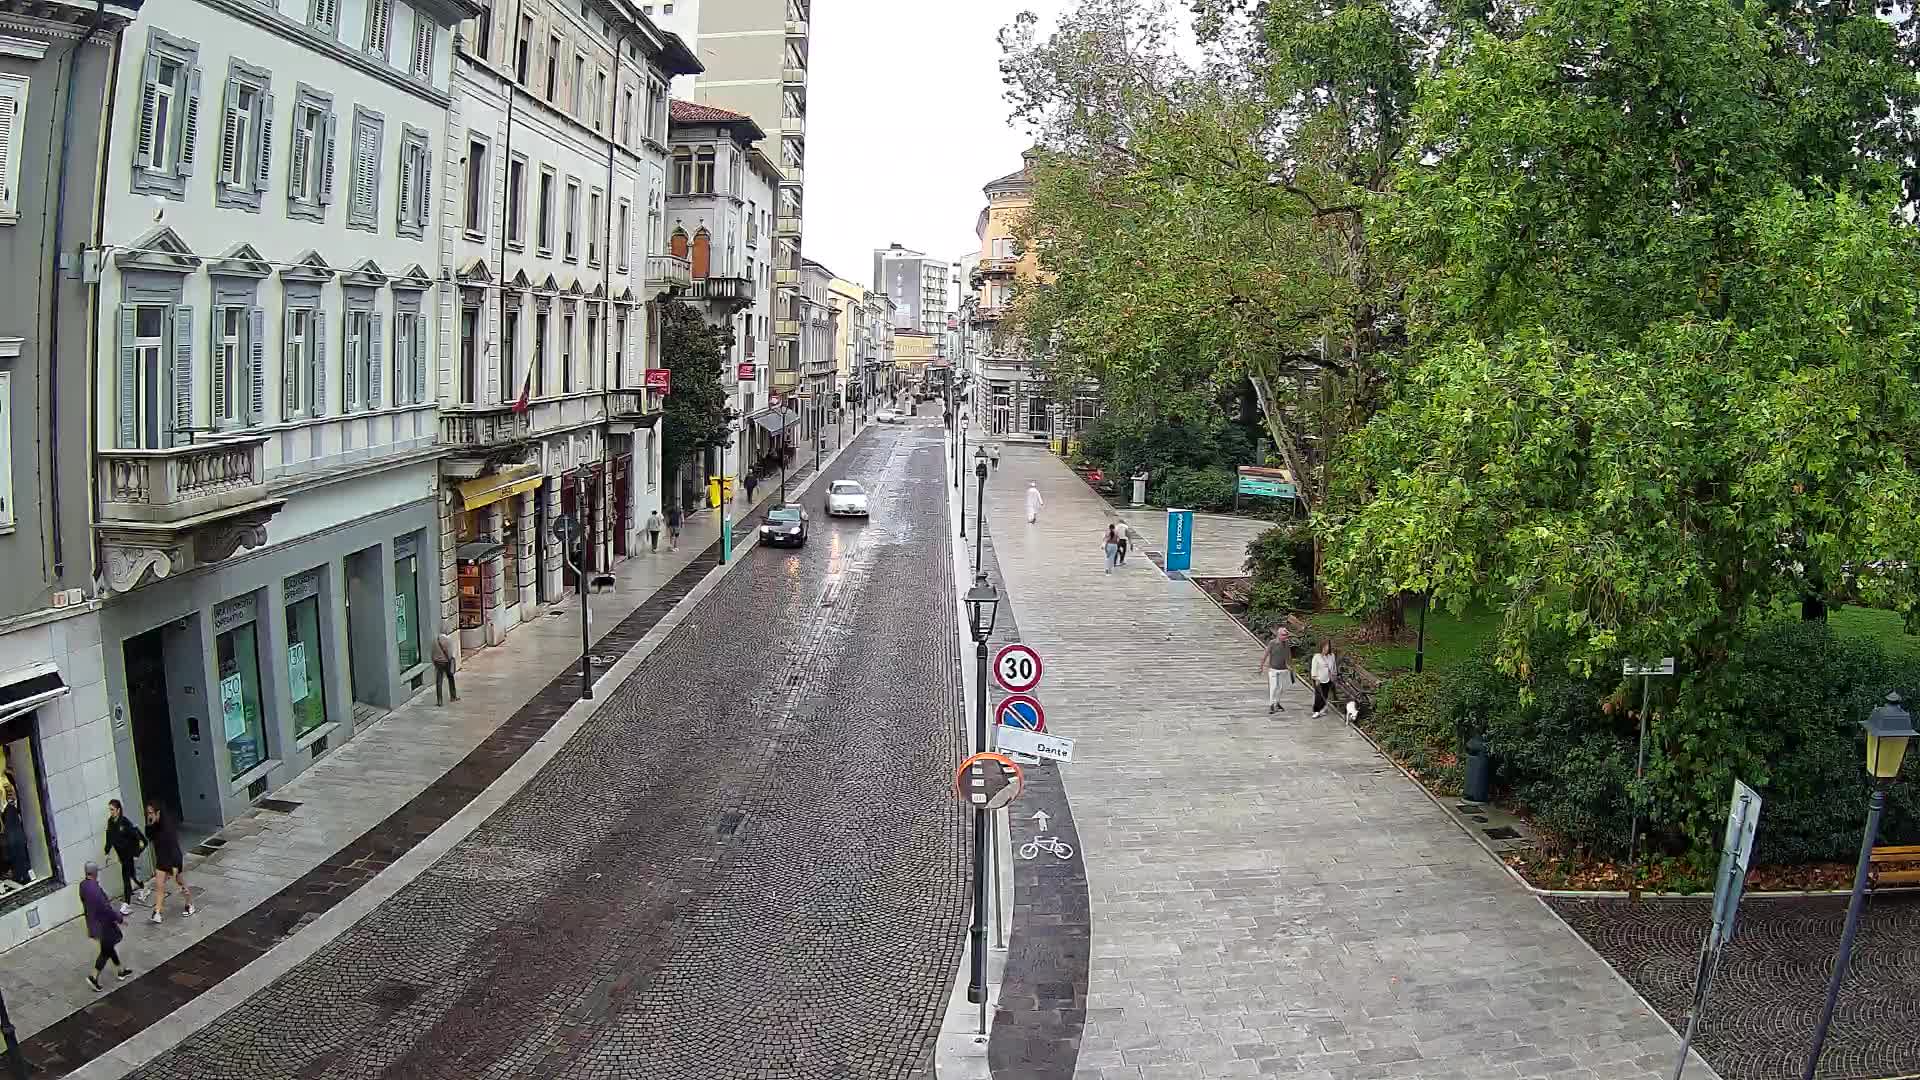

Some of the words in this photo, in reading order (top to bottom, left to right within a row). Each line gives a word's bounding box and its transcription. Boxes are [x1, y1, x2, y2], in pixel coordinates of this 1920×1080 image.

[1005, 657, 1032, 680] 30
[222, 677, 240, 700] 130
[1037, 743, 1068, 757] Dante
